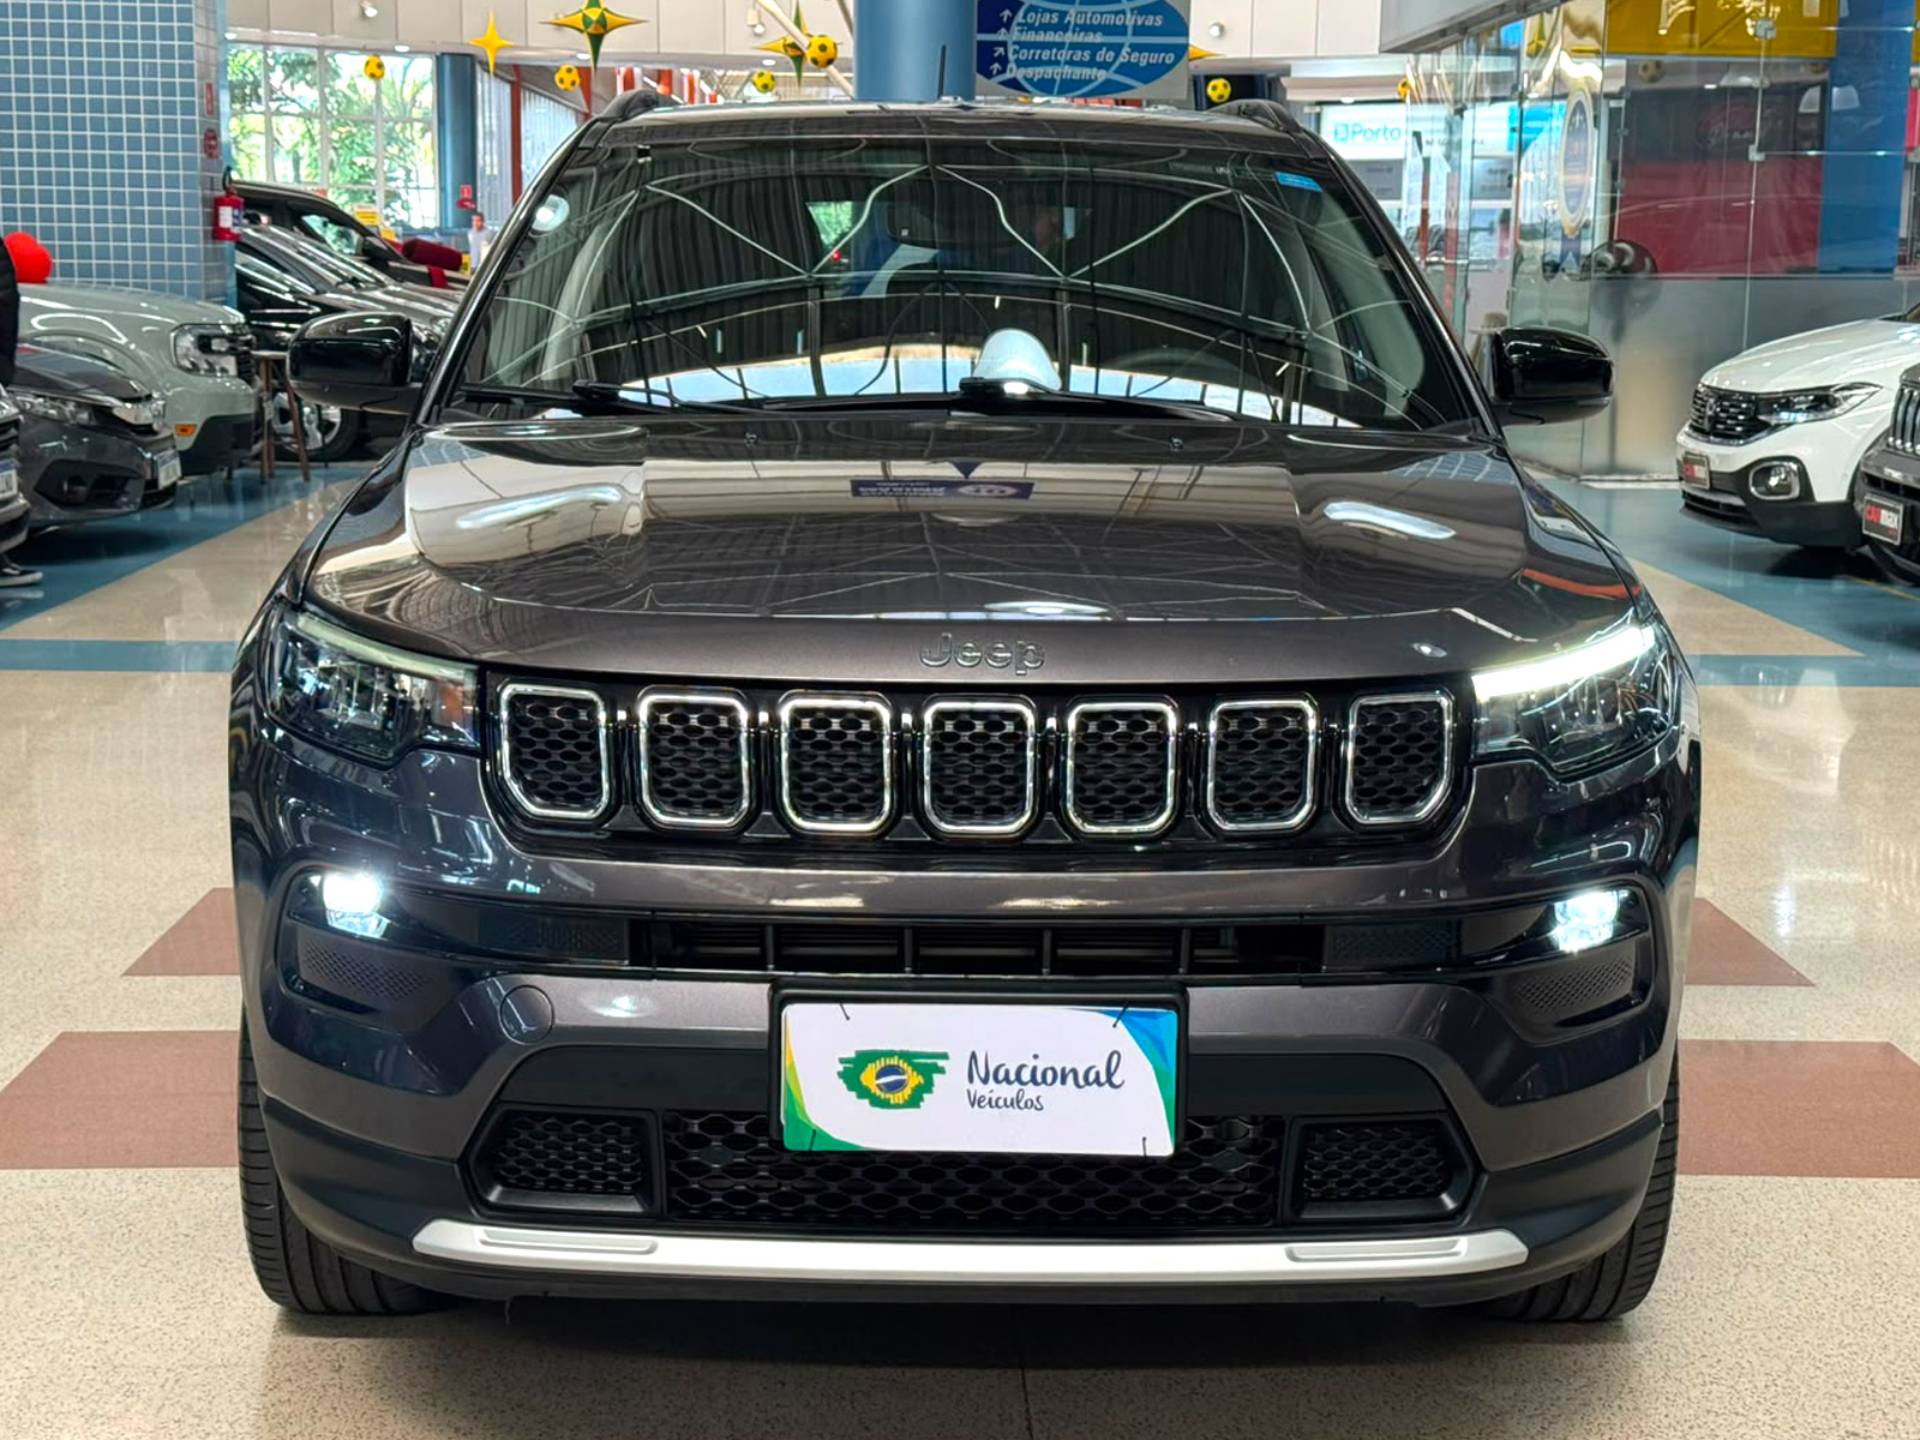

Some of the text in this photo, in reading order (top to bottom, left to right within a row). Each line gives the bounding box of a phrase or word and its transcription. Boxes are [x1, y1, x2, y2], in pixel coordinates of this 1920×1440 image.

[1018, 10, 1163, 26] Lojas Automotivas
[1012, 27, 1104, 42] Financeiras
[1009, 46, 1175, 66] Corretoras de Seguro
[1006, 65, 1106, 81] Despachante
[1351, 123, 1402, 141] Porto
[920, 632, 1045, 675] Jeep
[967, 1050, 1125, 1089] Nacional
[966, 1088, 1045, 1112] Veículos
